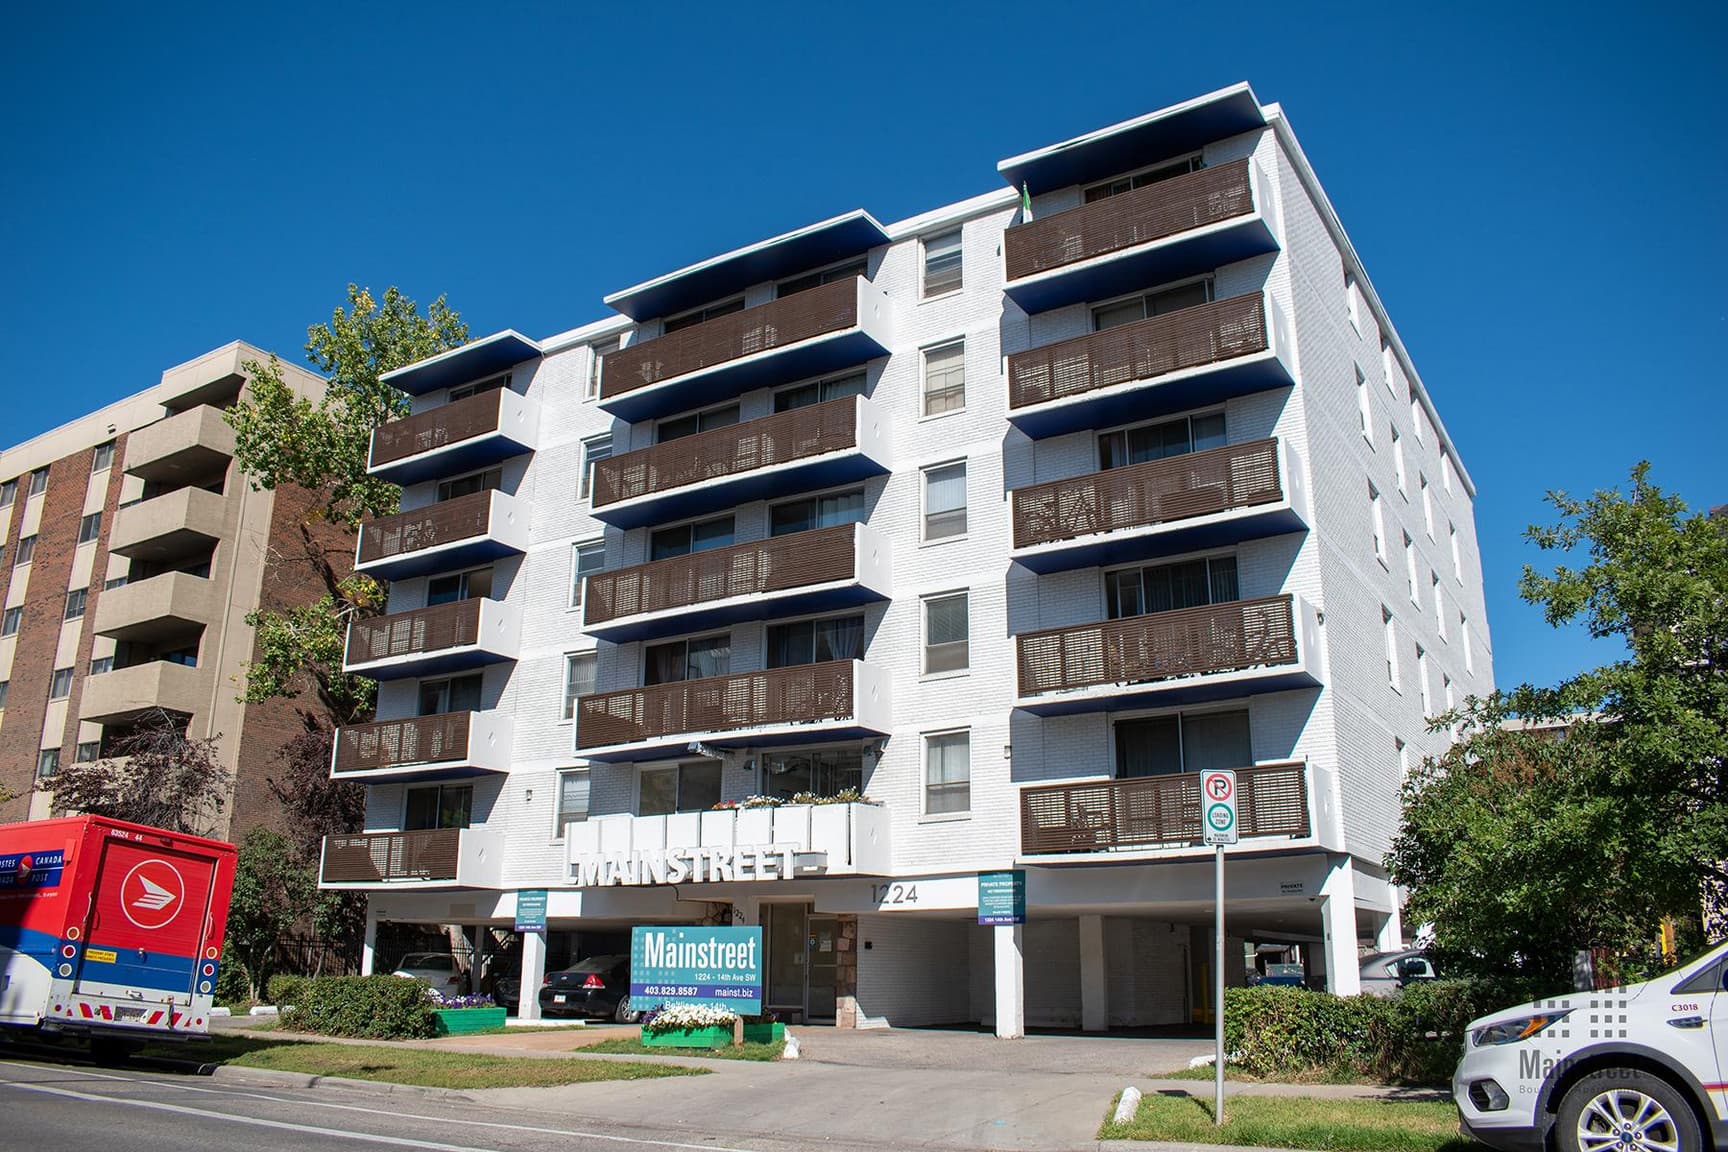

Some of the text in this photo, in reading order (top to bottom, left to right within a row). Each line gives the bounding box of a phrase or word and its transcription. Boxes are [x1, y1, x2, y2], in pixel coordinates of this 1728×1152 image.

[1214, 779, 1227, 796] P
[0, 855, 62, 868] STES CANADA
[574, 843, 800, 887] MAINSTREET
[871, 884, 918, 904] 1224
[644, 932, 756, 969] Mainstreet
[694, 973, 711, 981] 1224
[717, 973, 731, 981] 14th
[731, 973, 744, 982] Ave
[744, 973, 756, 982] SW
[644, 986, 753, 998] 403.829.8587 mainst.biz
[1671, 1003, 1699, 1012] C3018
